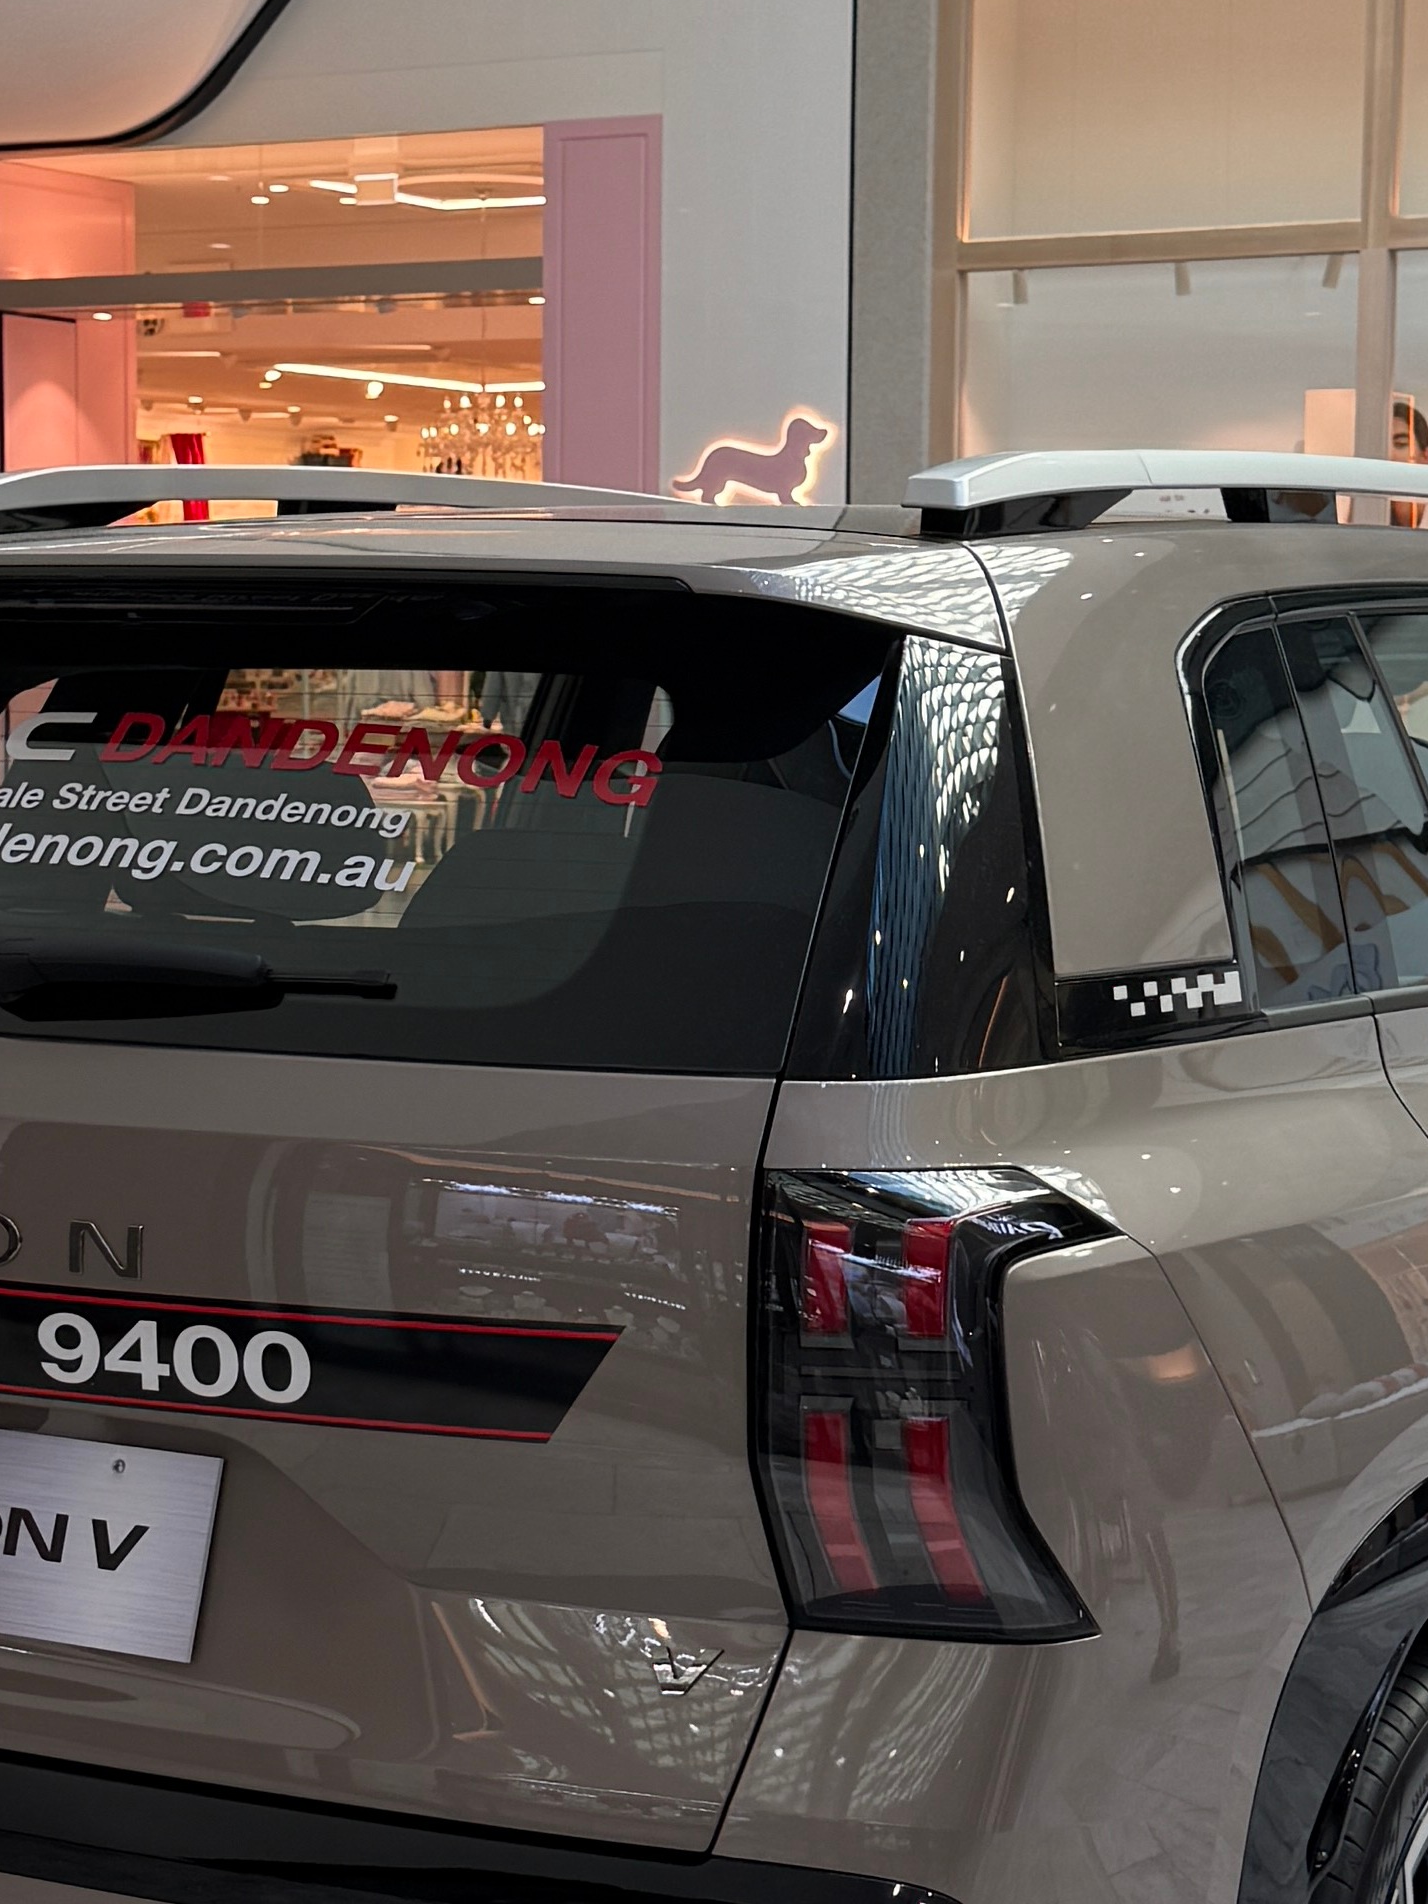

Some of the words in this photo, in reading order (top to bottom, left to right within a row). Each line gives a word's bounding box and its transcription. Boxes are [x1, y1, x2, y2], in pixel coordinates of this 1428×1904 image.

[99, 711, 663, 807] DANDENONG
[52, 782, 171, 815] Street
[176, 787, 412, 838] Dandenong
[36, 1311, 312, 1404] 9400
[91, 1518, 150, 1571] V
